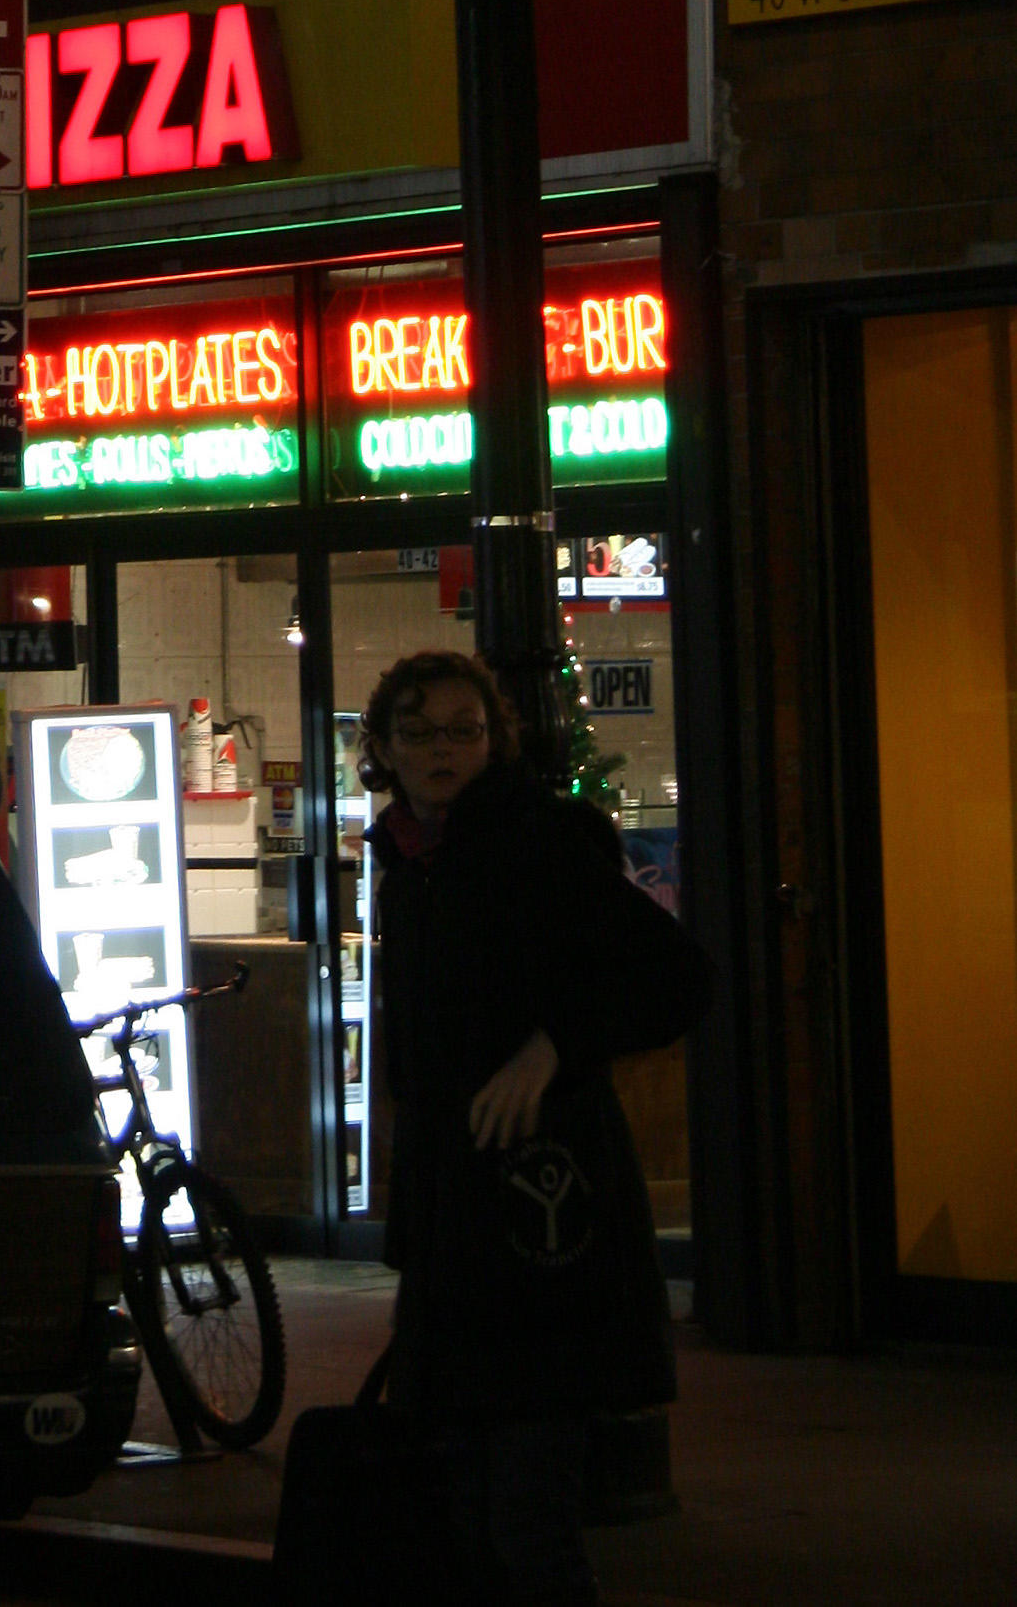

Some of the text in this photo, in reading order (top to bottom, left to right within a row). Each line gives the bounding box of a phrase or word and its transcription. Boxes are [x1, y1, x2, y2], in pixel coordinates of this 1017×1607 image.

[26, 3, 273, 191] IZZA
[350, 315, 471, 394] BREAK
[591, 665, 652, 708] OPEN
